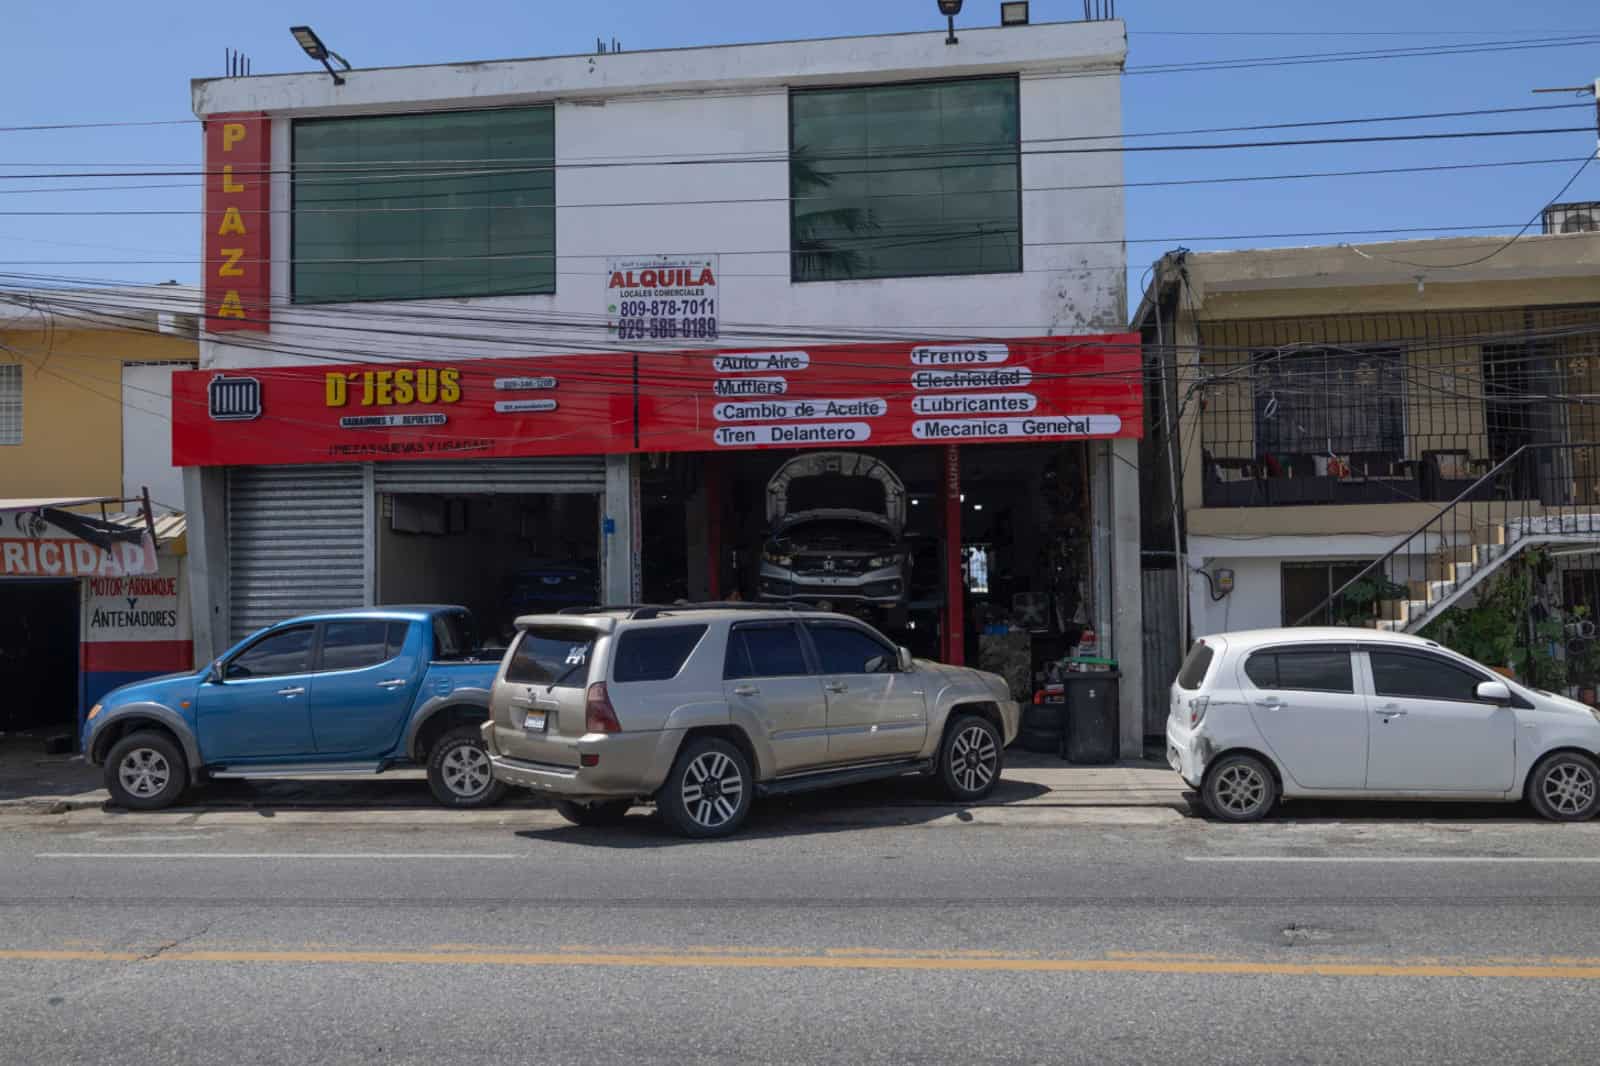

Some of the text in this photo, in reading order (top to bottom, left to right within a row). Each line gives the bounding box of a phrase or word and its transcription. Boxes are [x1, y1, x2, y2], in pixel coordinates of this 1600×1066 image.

[218, 123, 247, 319] PLAZA
[609, 267, 716, 289] ALQUILA
[620, 288, 705, 298] LOCALES COMERCIALES
[620, 299, 715, 317] 809-878-7011
[720, 355, 801, 370] Auto Aire
[918, 349, 988, 363] Frenos
[723, 401, 880, 420] Cambio de Aceite
[920, 397, 1029, 413] Lubricantes
[719, 425, 855, 442] Tren Delantero
[925, 417, 1090, 437] Mecanica General
[91, 576, 122, 596] MOTOR
[127, 598, 138, 609] Y
[91, 608, 177, 628] ANTENADORES
